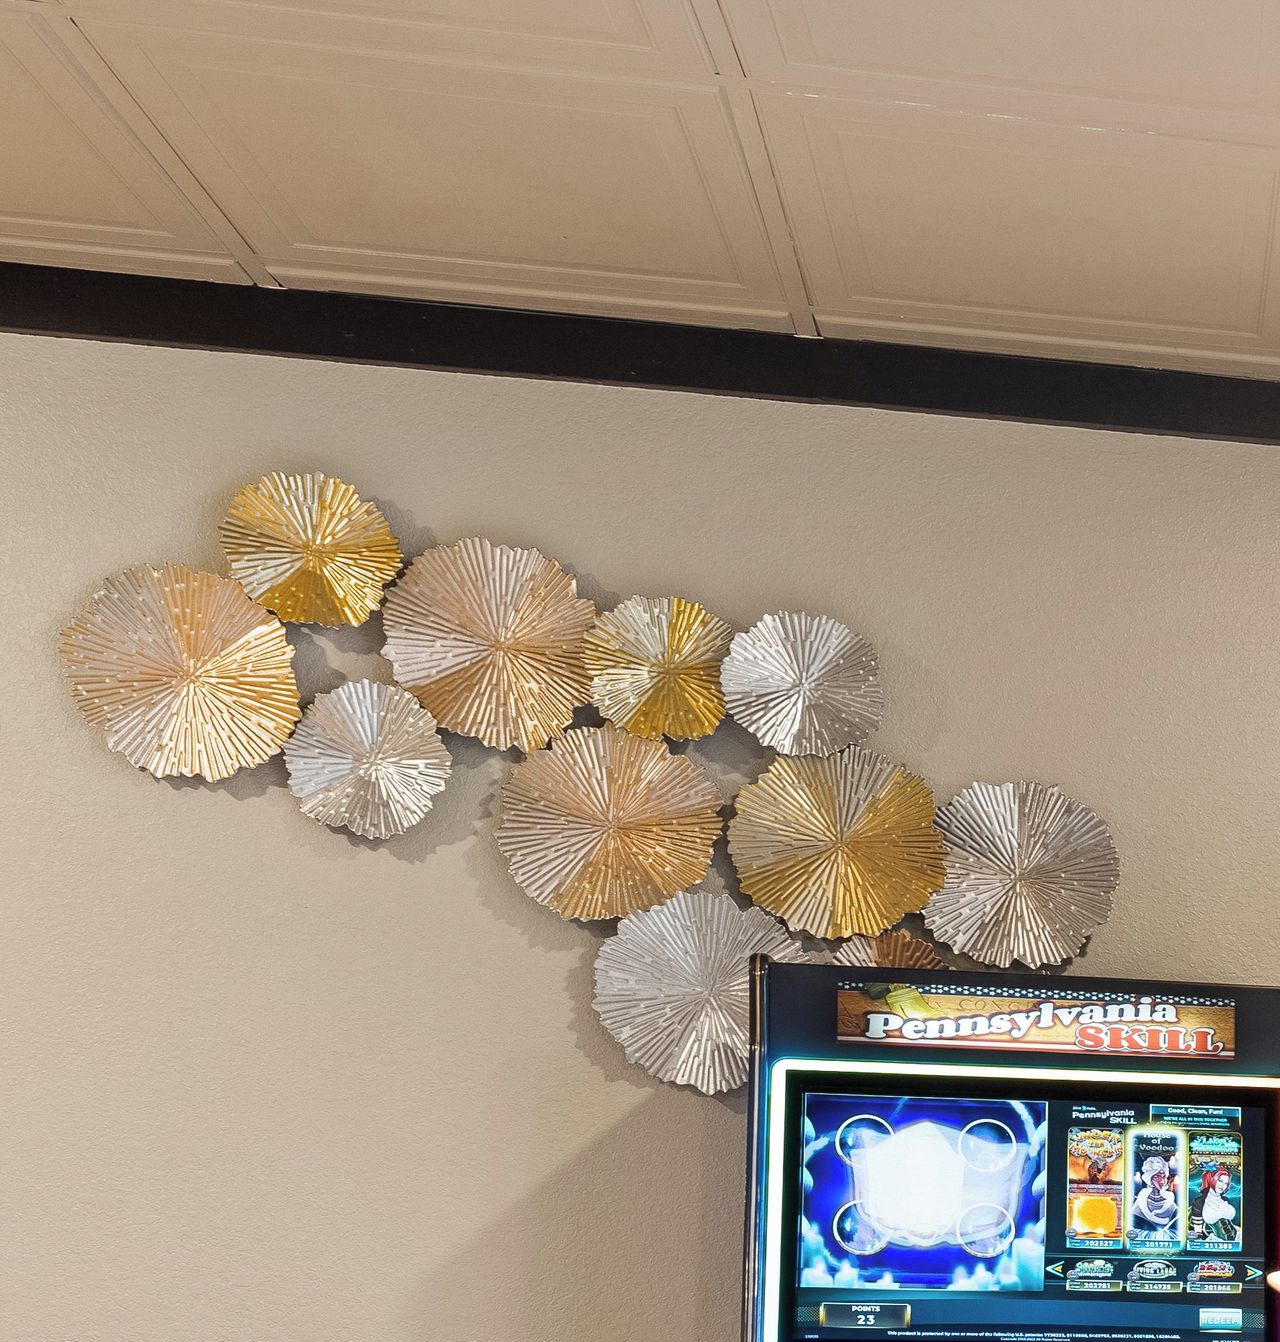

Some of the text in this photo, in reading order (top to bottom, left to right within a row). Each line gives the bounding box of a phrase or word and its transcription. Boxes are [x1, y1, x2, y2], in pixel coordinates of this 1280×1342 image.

[865, 996, 1178, 1040] Pennsylvania
[1075, 1023, 1224, 1055] SKILL
[1072, 1109, 1135, 1119] Pennsylvania
[1167, 1107, 1187, 1115] Good,
[1109, 1116, 1137, 1125] SKILL
[1152, 1137, 1160, 1145] of
[1139, 1143, 1175, 1151] Voodoo
[856, 1314, 876, 1325] 23
[1201, 1316, 1241, 1325] REDEEM
